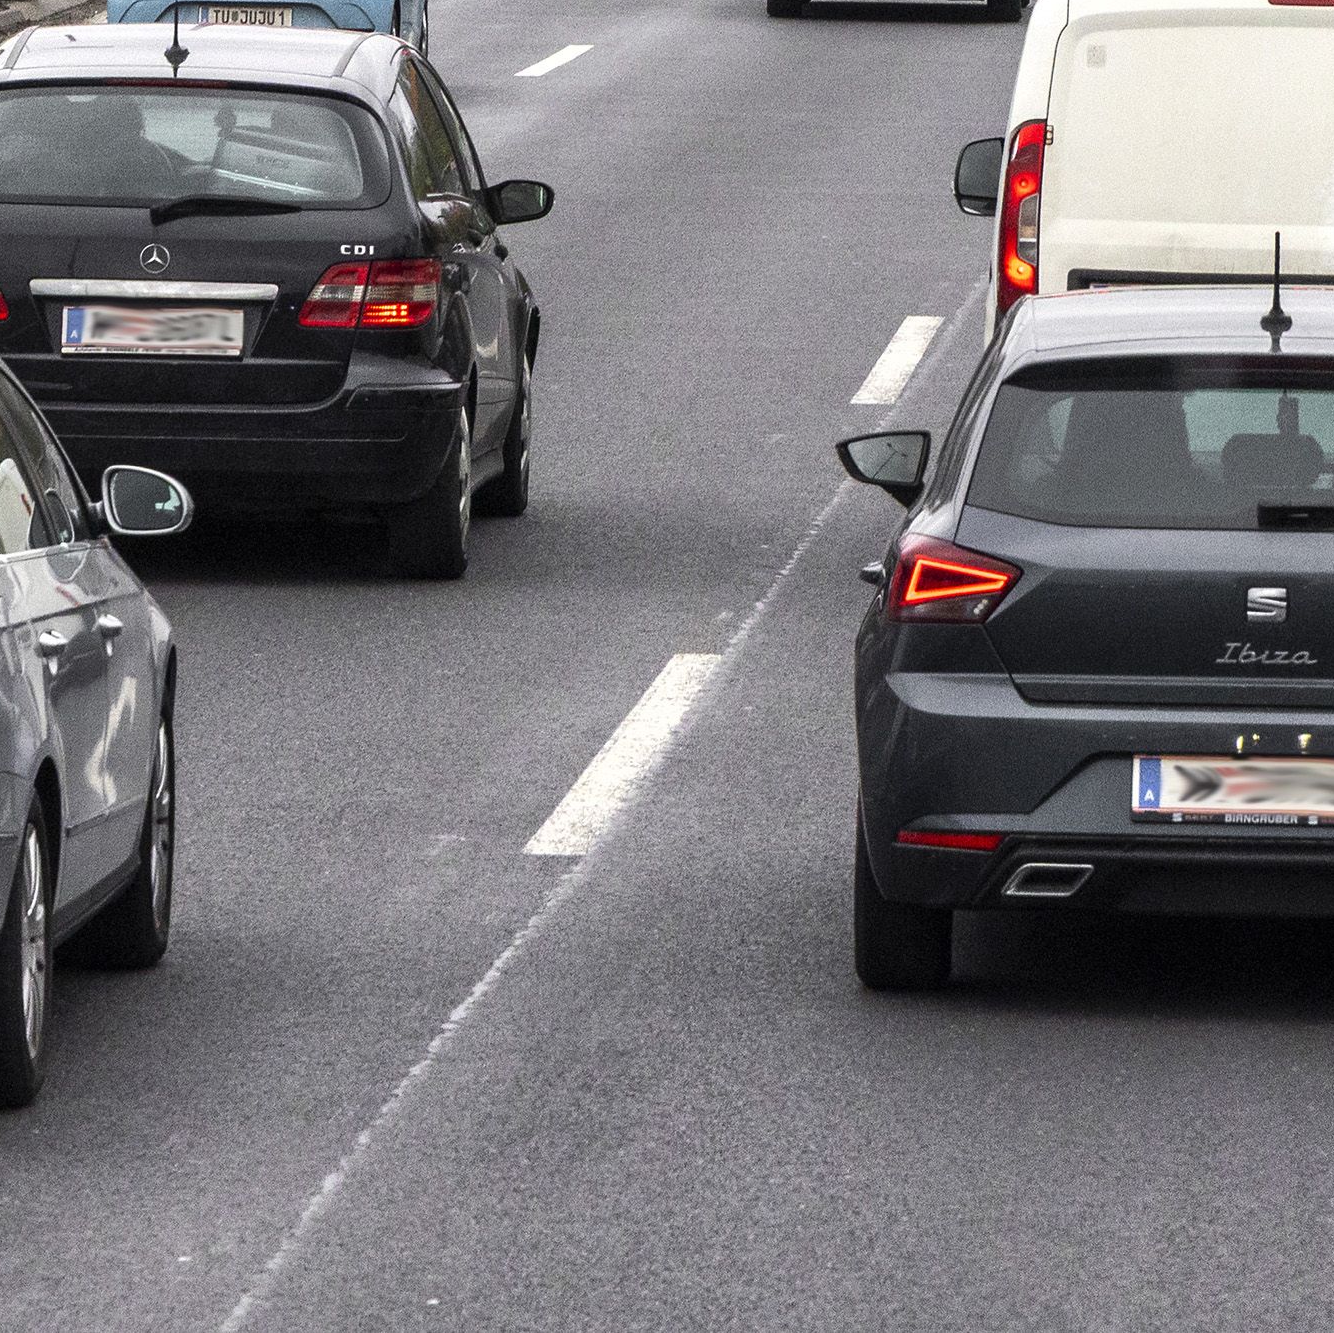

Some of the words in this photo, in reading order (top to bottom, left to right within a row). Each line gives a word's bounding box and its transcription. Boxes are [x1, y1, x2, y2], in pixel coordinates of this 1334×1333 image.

[340, 244, 374, 255] CDI
[70, 330, 79, 339] A
[1215, 643, 1318, 664] Ibiza
[1143, 789, 1155, 802] A
